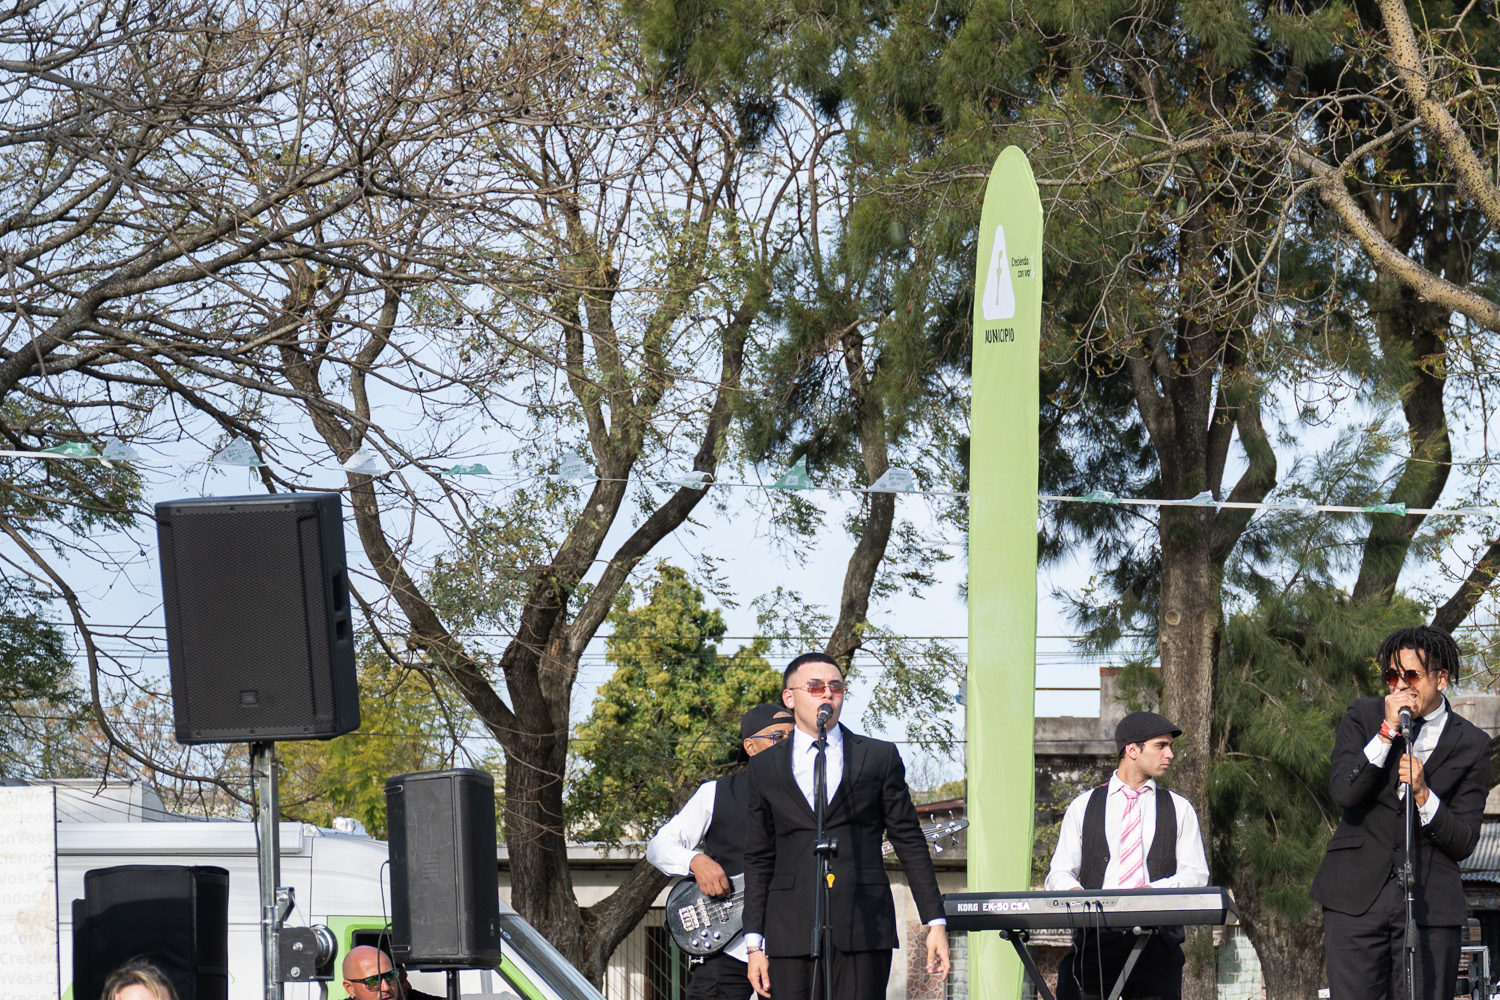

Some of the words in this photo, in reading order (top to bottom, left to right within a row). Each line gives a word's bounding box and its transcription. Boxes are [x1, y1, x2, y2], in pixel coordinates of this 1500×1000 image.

[1011, 256, 1029, 267] Creciendo
[985, 327, 1015, 344] MUNICIPIO
[957, 903, 979, 912] KORG
[1010, 901, 1030, 911] CSA
